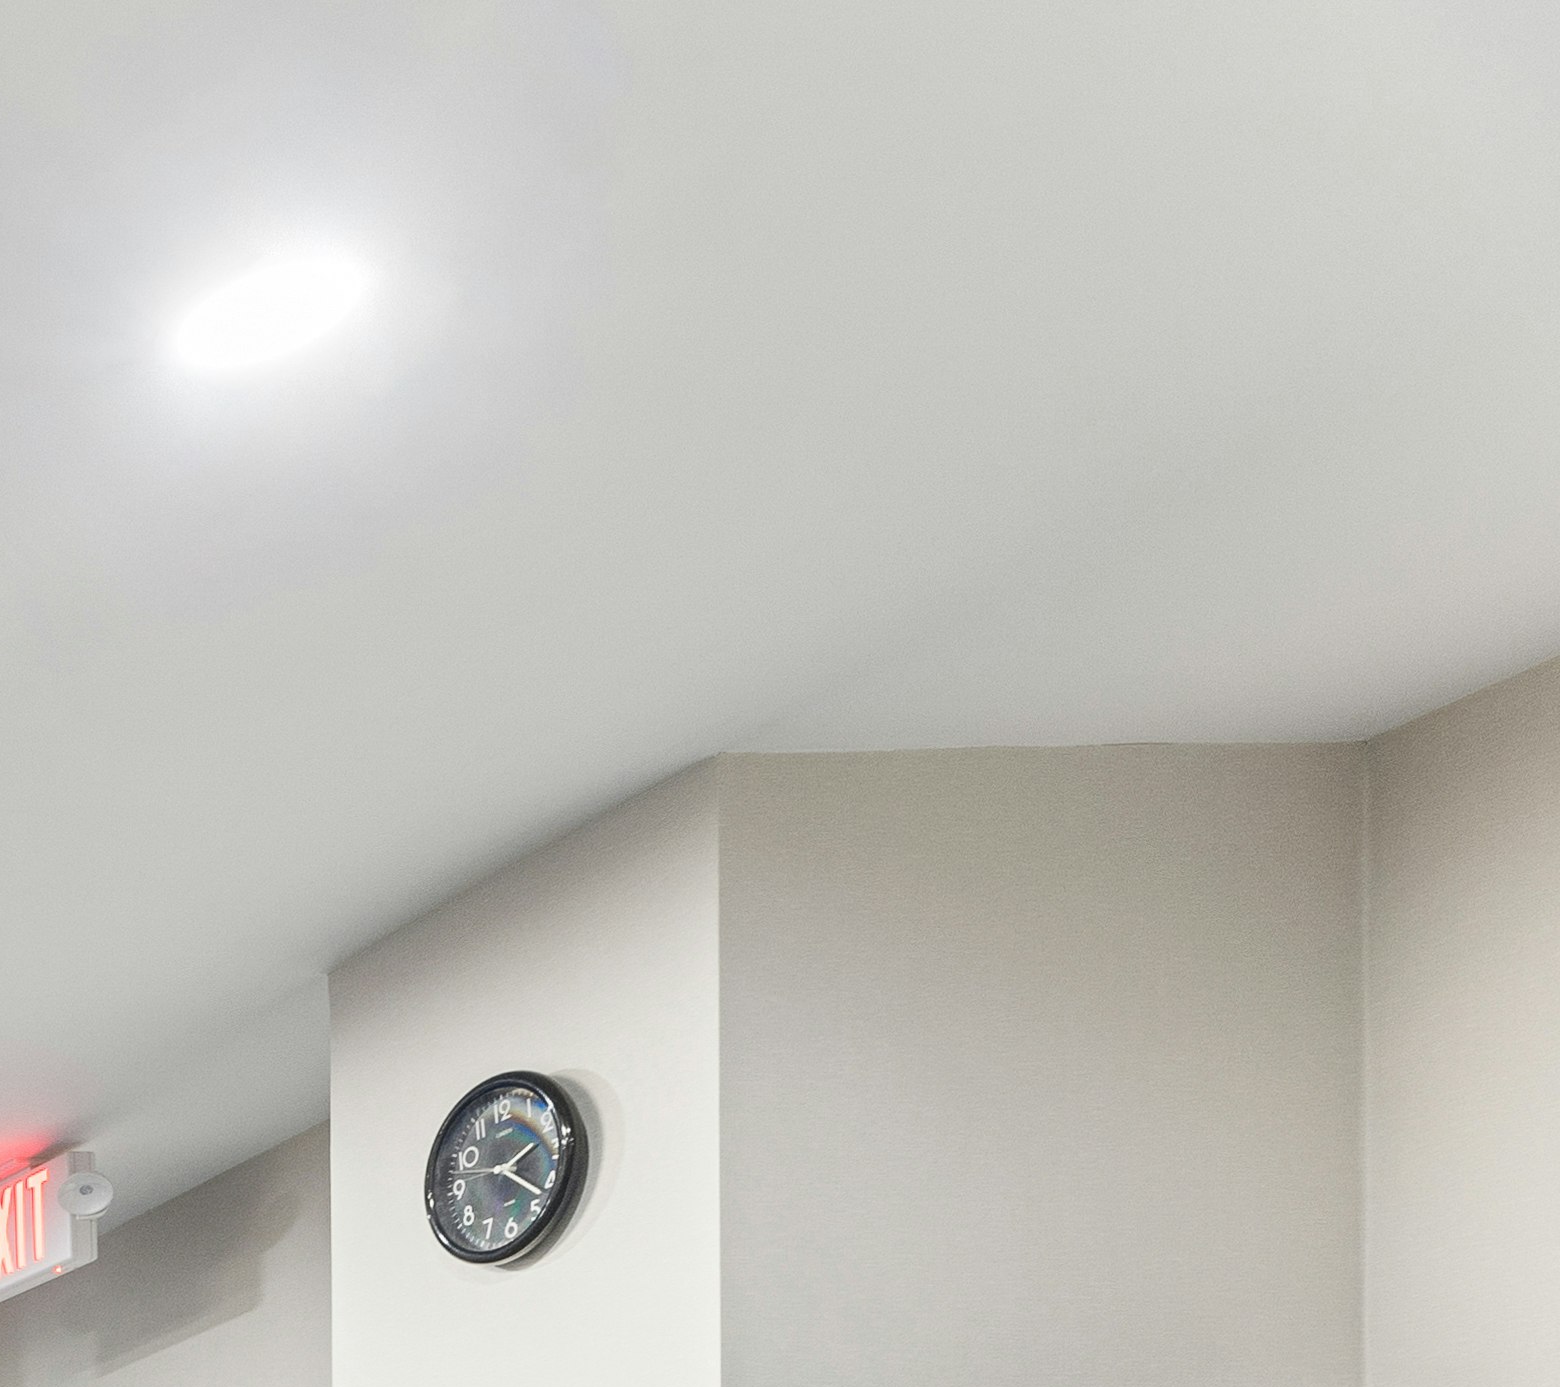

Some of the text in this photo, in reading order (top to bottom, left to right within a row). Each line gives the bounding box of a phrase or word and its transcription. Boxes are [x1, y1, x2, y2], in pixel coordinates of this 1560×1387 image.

[494, 1098, 512, 1123] 12
[526, 1098, 532, 1117] 1
[475, 1118, 486, 1140] 11
[540, 1111, 554, 1133] 2
[458, 1146, 479, 1170] 10
[453, 1179, 465, 1200] 9
[463, 1205, 474, 1226] 8
[530, 1199, 541, 1220] 5
[483, 1218, 493, 1239] 7
[505, 1217, 518, 1238] 6
